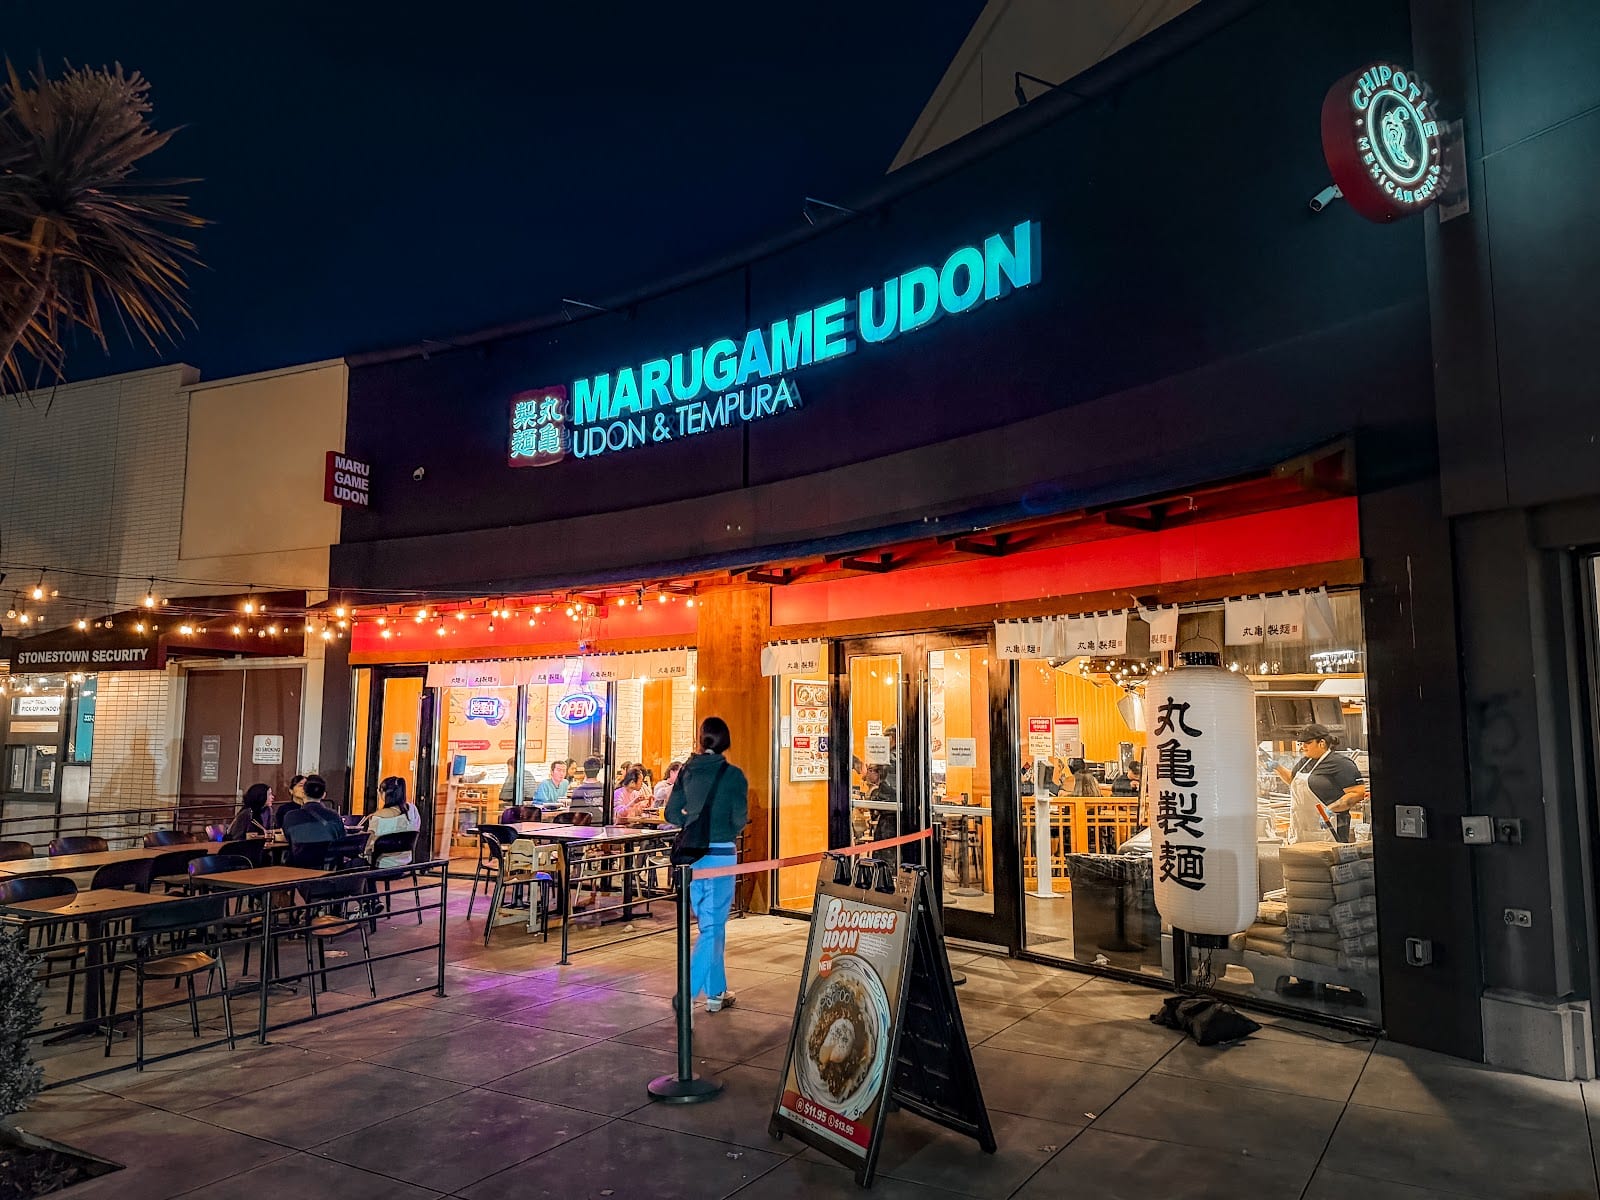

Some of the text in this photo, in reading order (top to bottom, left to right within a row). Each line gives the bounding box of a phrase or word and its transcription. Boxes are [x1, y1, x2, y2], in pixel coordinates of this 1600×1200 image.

[1353, 65, 1439, 139] CHIPOTLE
[1357, 136, 1414, 203] MEXICAN
[573, 219, 1032, 427] MARUGAME UDON
[573, 377, 795, 459] UDON & TEMPURA
[335, 455, 370, 477] MARU
[334, 471, 370, 492] GAME
[333, 485, 369, 506] UDON
[1242, 623, 1291, 637] 丸亀製麺
[1077, 639, 1117, 650] 丸亀製麺
[18, 648, 149, 665] STONESTOWN SECURITY
[560, 699, 594, 718] OPEN
[1154, 696, 1207, 891] 丸亀製麺
[824, 897, 897, 932] BOLOGNESE
[822, 930, 859, 950] UDON
[818, 960, 833, 972] NEW
[803, 1101, 828, 1123] $11.95
[834, 1118, 855, 1136] $13.95
